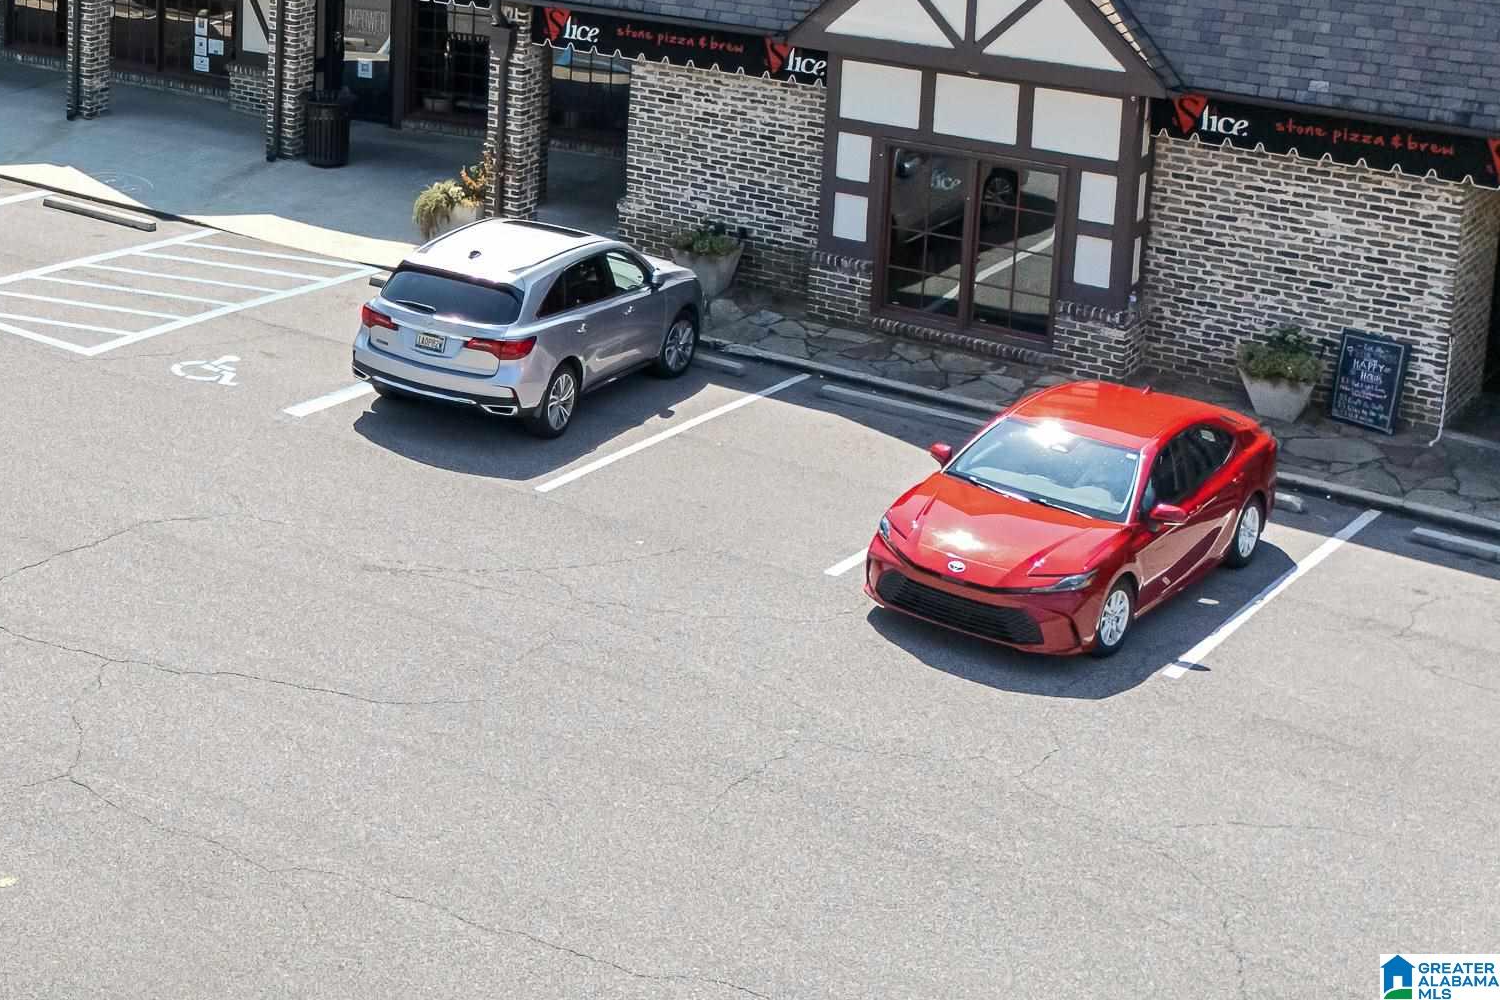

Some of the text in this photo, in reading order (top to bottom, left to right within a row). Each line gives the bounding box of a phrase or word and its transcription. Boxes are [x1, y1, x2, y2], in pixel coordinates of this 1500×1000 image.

[616, 23, 653, 40] stone
[656, 31, 695, 51] pizza
[709, 36, 745, 54] brew
[1275, 117, 1327, 137] stone
[1331, 127, 1386, 148] pizza
[1406, 133, 1454, 157] brew
